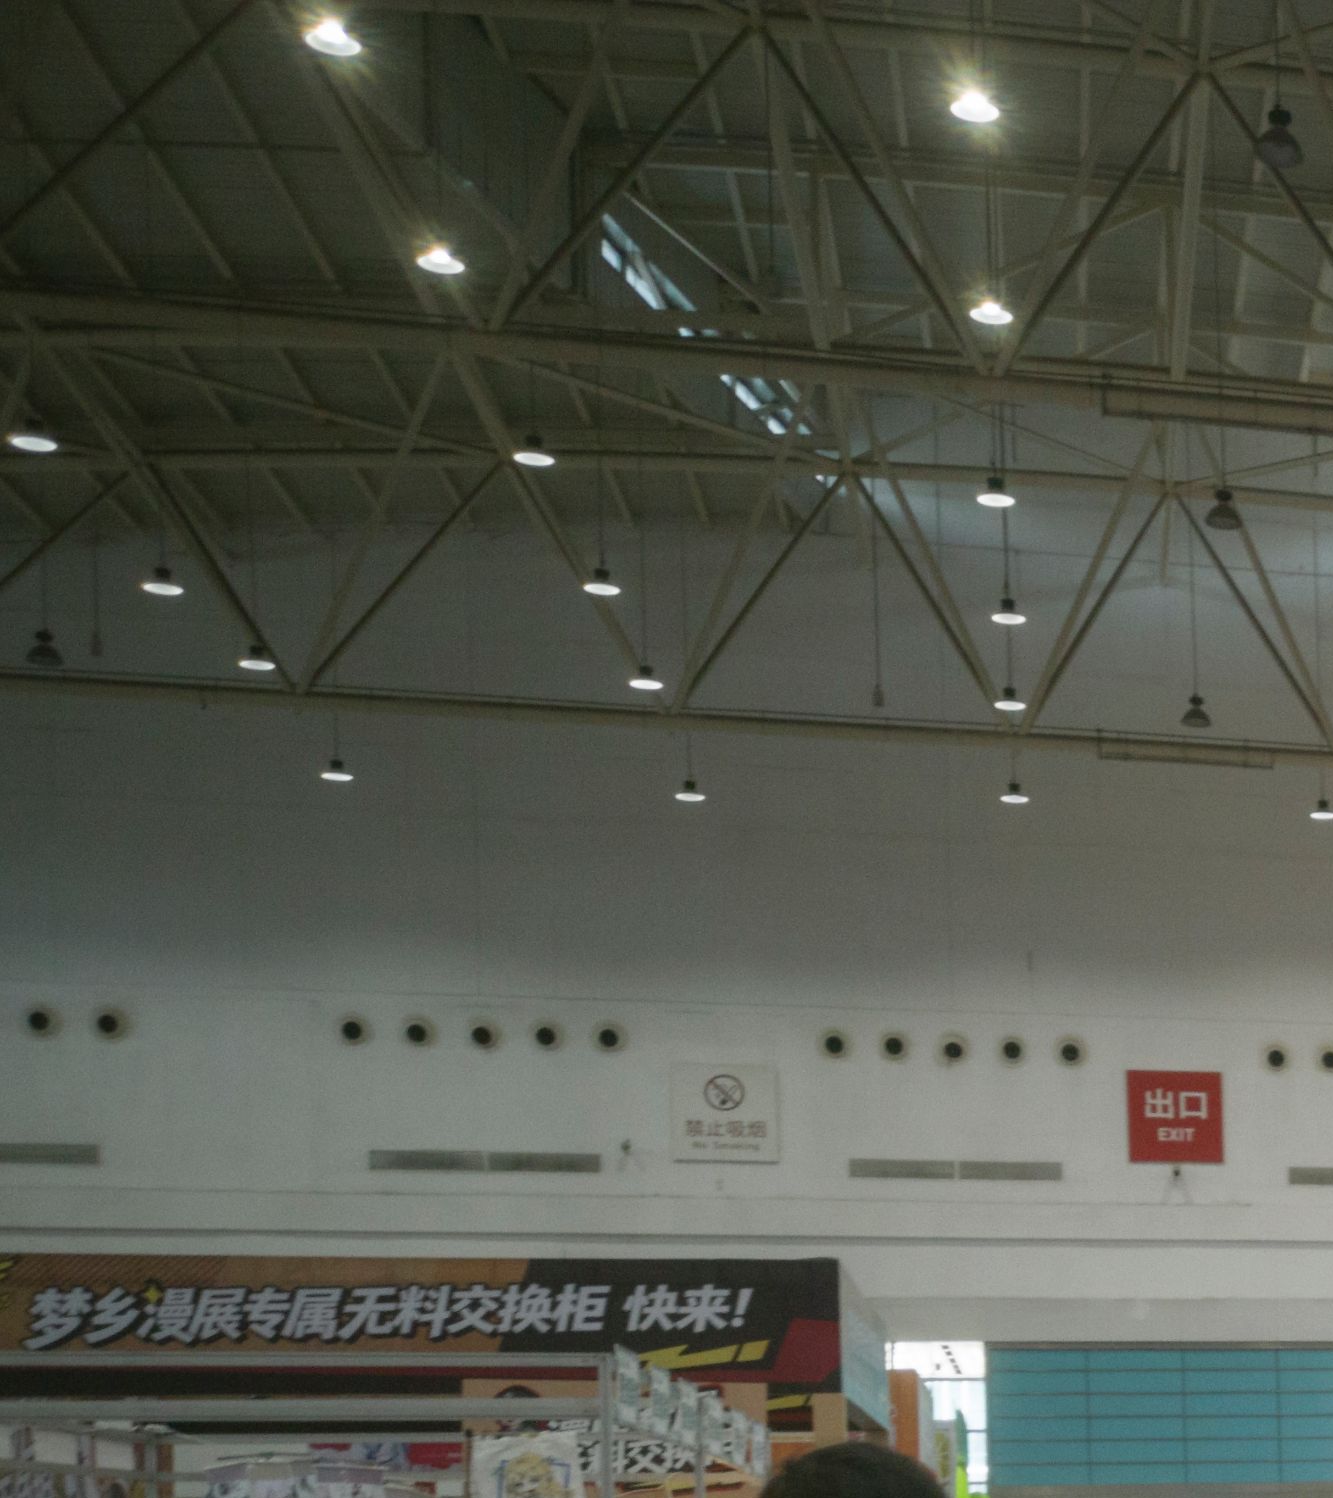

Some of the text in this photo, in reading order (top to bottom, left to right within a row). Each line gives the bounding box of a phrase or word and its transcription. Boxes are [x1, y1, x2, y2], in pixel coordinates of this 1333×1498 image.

[1144, 1087, 1208, 1120] 出口
[685, 1119, 767, 1138] 禁止吸烟
[1157, 1126, 1196, 1142] EXIT
[22, 1282, 612, 1351] 梦乡漫展专属无料交换柜
